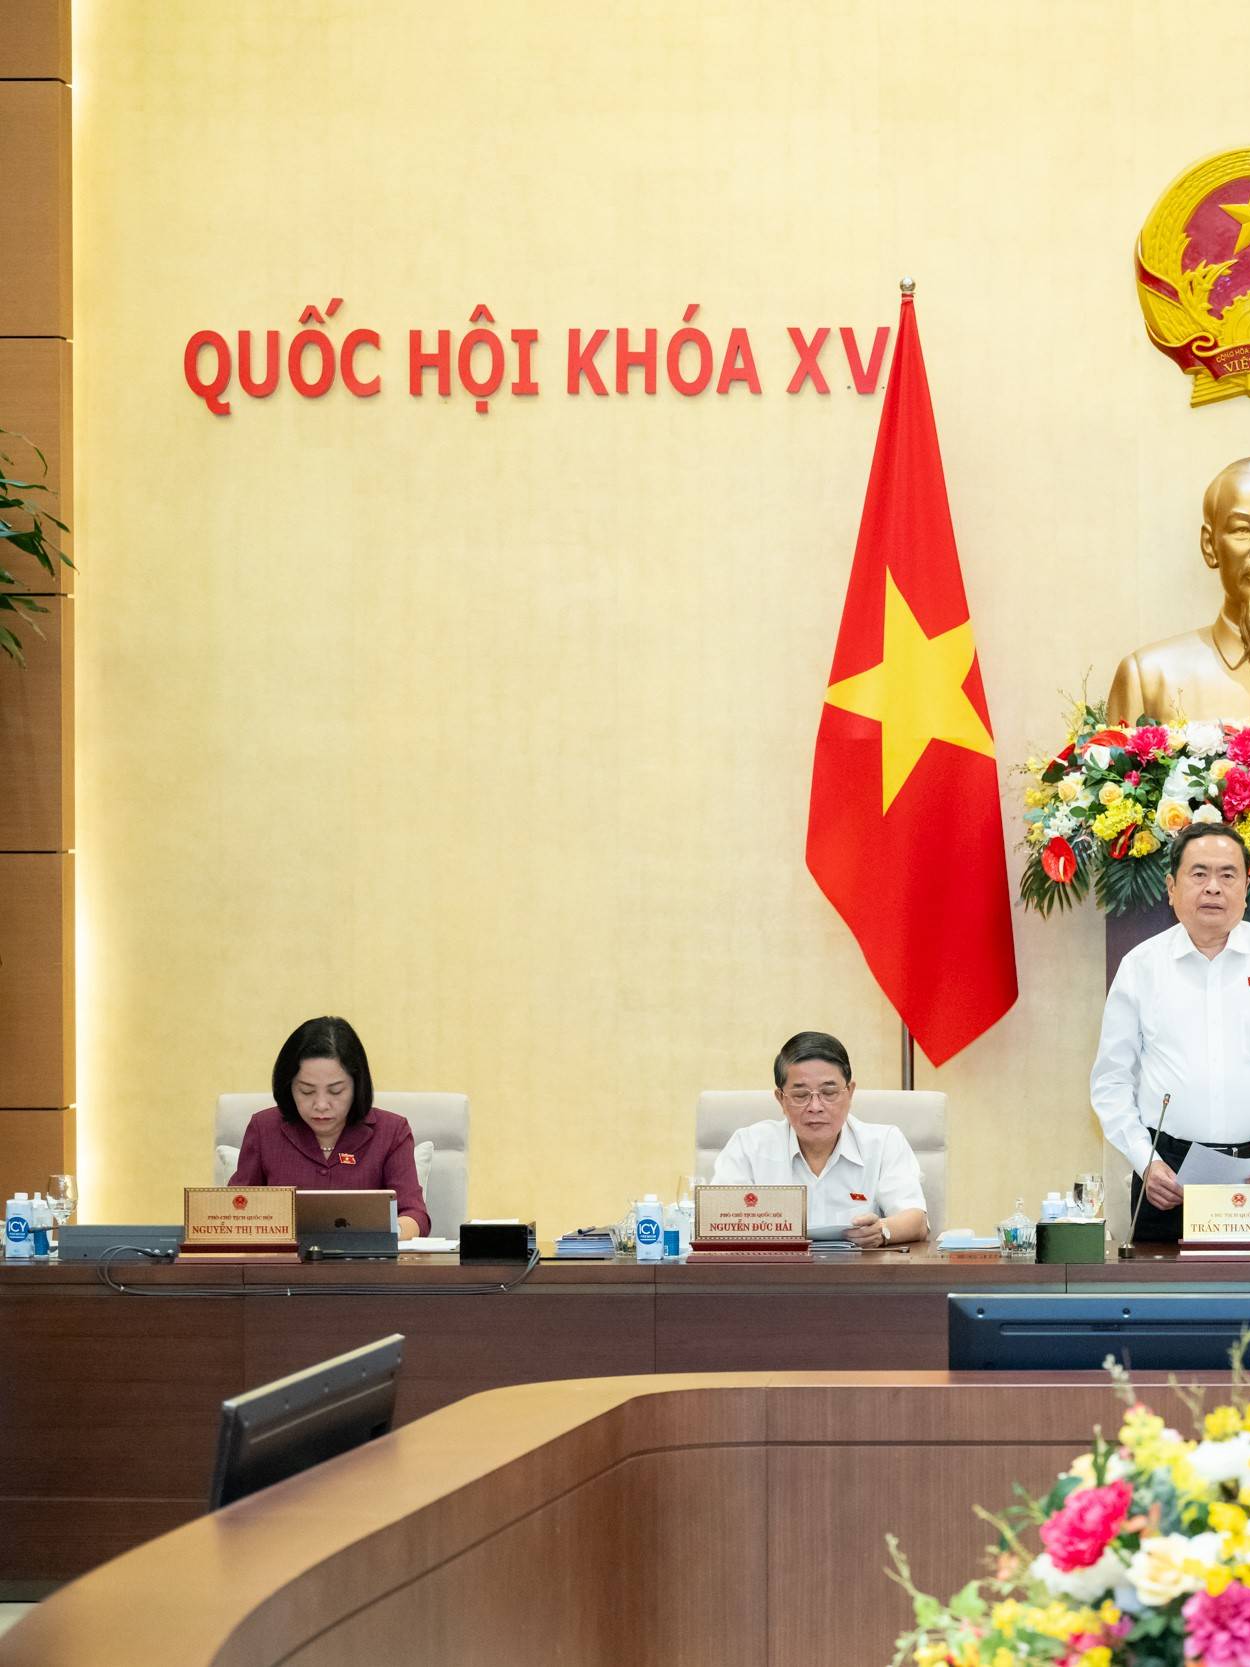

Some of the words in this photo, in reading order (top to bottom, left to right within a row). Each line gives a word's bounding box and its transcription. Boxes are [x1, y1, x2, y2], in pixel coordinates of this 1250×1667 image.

[184, 298, 380, 415] QUỐC
[410, 304, 538, 413] HỘI
[567, 304, 761, 396] KHÓA
[786, 326, 891, 395] XV
[8, 1221, 27, 1232] ICY
[192, 1221, 233, 1234] NGUYỄN
[235, 1225, 252, 1236] THỊ
[256, 1225, 289, 1234] THANH
[638, 1223, 658, 1235] ICY
[710, 1219, 750, 1231] NGUYỄN
[752, 1220, 773, 1231] ĐỨC
[775, 1219, 793, 1231] HẢI
[1191, 1219, 1220, 1232] TRẦN
